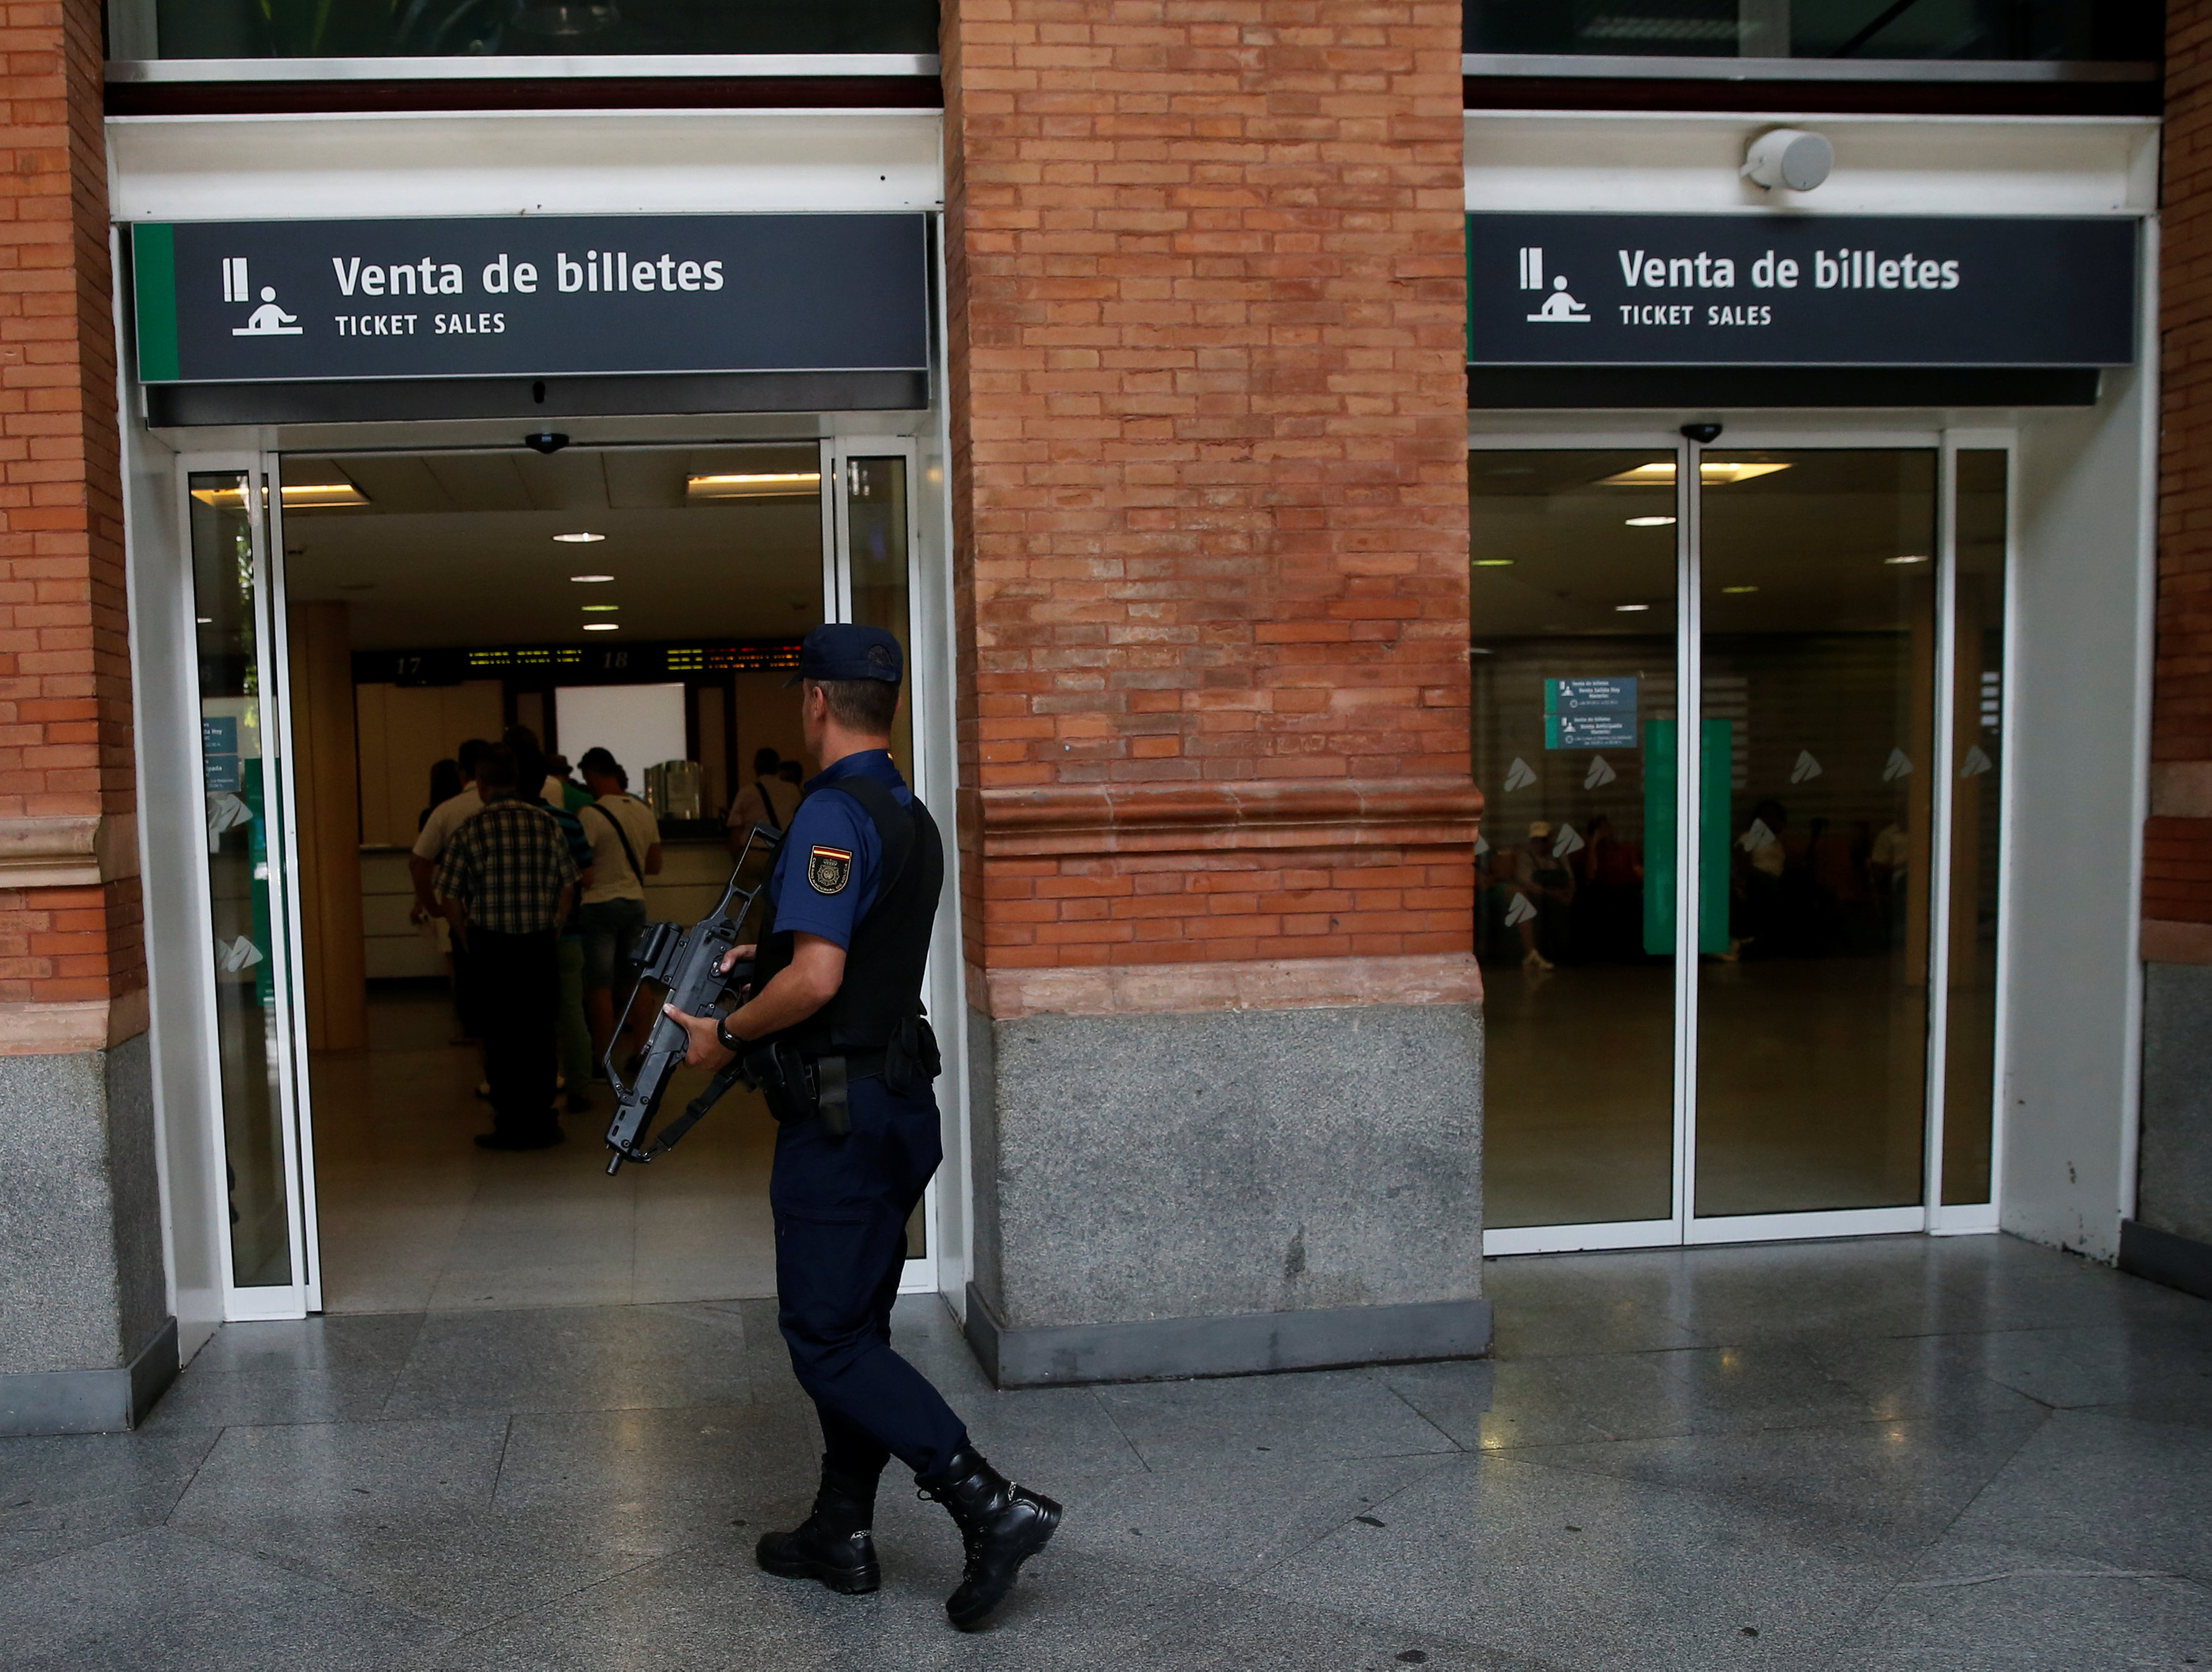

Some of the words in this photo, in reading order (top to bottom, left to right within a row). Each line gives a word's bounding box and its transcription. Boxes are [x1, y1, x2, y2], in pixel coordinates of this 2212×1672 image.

[332, 257, 463, 296] Venta
[482, 253, 538, 294] de
[557, 250, 724, 293] billetes
[1619, 250, 1735, 289] Venta
[1752, 249, 1799, 289] de
[1815, 248, 1960, 291] billetes
[334, 315, 418, 336] TICKET
[434, 313, 506, 334] SALES
[1619, 305, 1694, 325] TICKET
[1708, 305, 1771, 326] SALES
[395, 657, 422, 675] 17
[602, 651, 628, 669] 18
